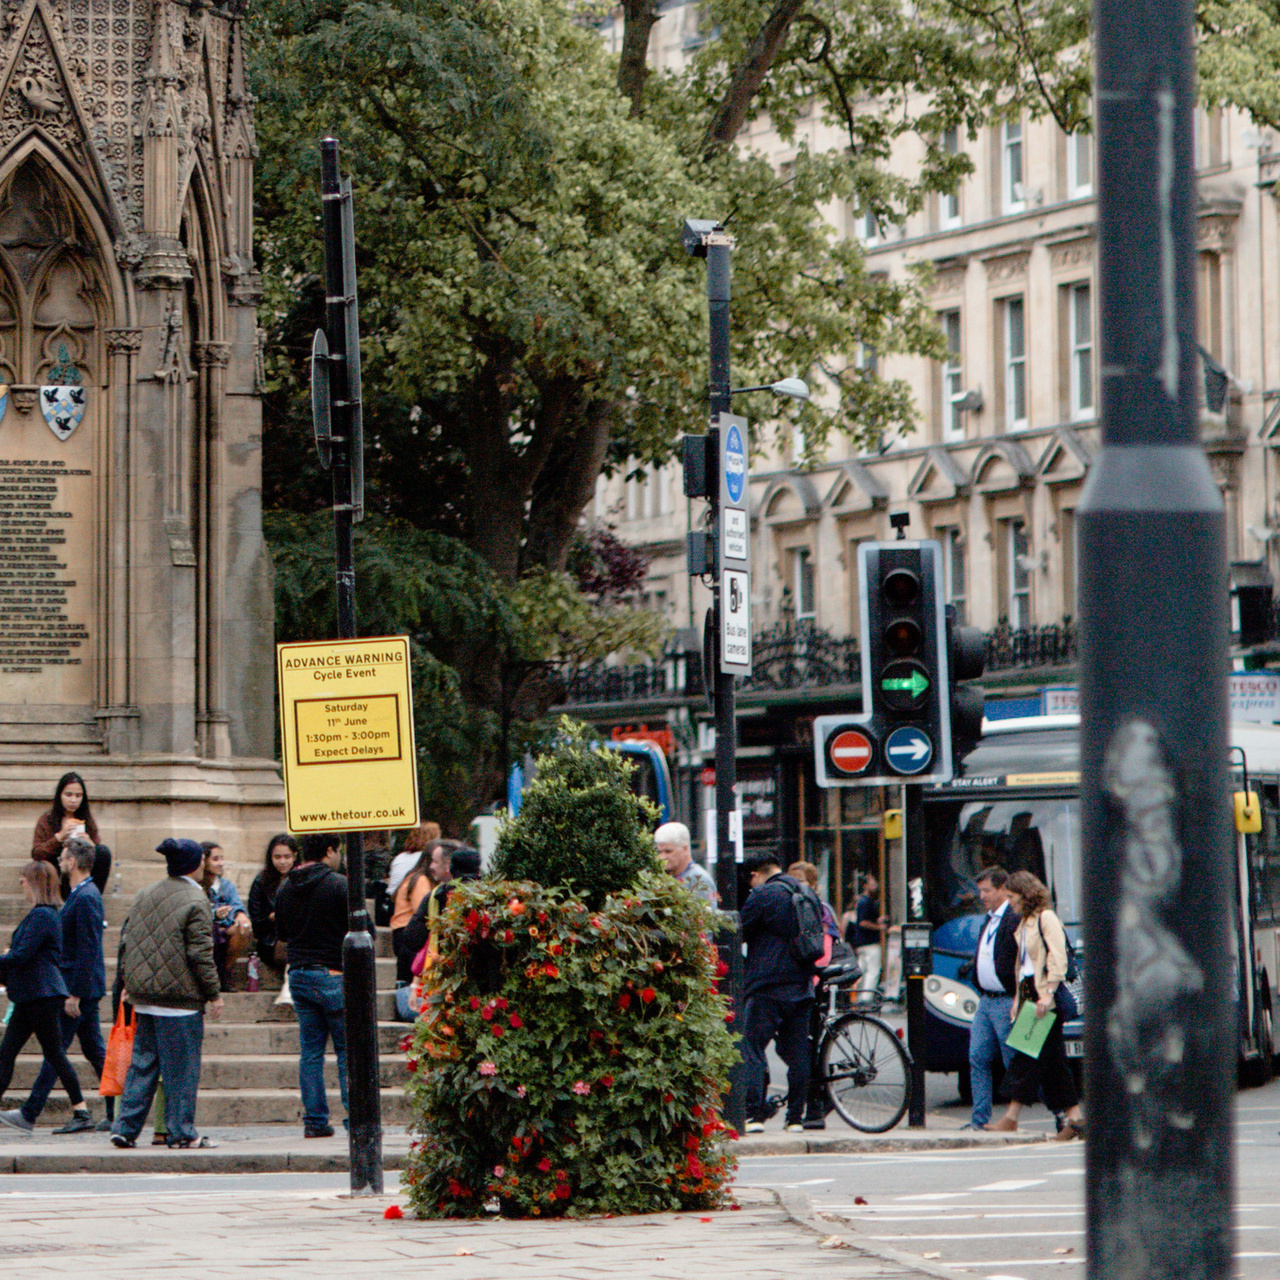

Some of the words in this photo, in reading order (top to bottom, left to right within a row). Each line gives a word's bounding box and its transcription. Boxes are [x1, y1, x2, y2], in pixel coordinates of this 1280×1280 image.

[726, 622, 736, 636] Bus
[727, 643, 747, 656] cameras
[285, 655, 341, 668] ADVANCE
[345, 651, 403, 665] WARNING
[313, 669, 343, 682] Cycle
[346, 668, 377, 678] Event
[1232, 680, 1278, 691] TESCO
[324, 702, 369, 713] Saturday
[1231, 697, 1275, 710] express
[327, 718, 342, 727] 11th
[344, 717, 368, 726] June
[306, 733, 342, 745] 1:30pm
[351, 730, 390, 743] 3:00pm
[314, 747, 348, 759] Expect
[351, 744, 384, 757] Delays
[951, 778, 971, 788] STAY
[972, 776, 999, 787] ALERT
[300, 807, 406, 822] www.thetour.co.uk
